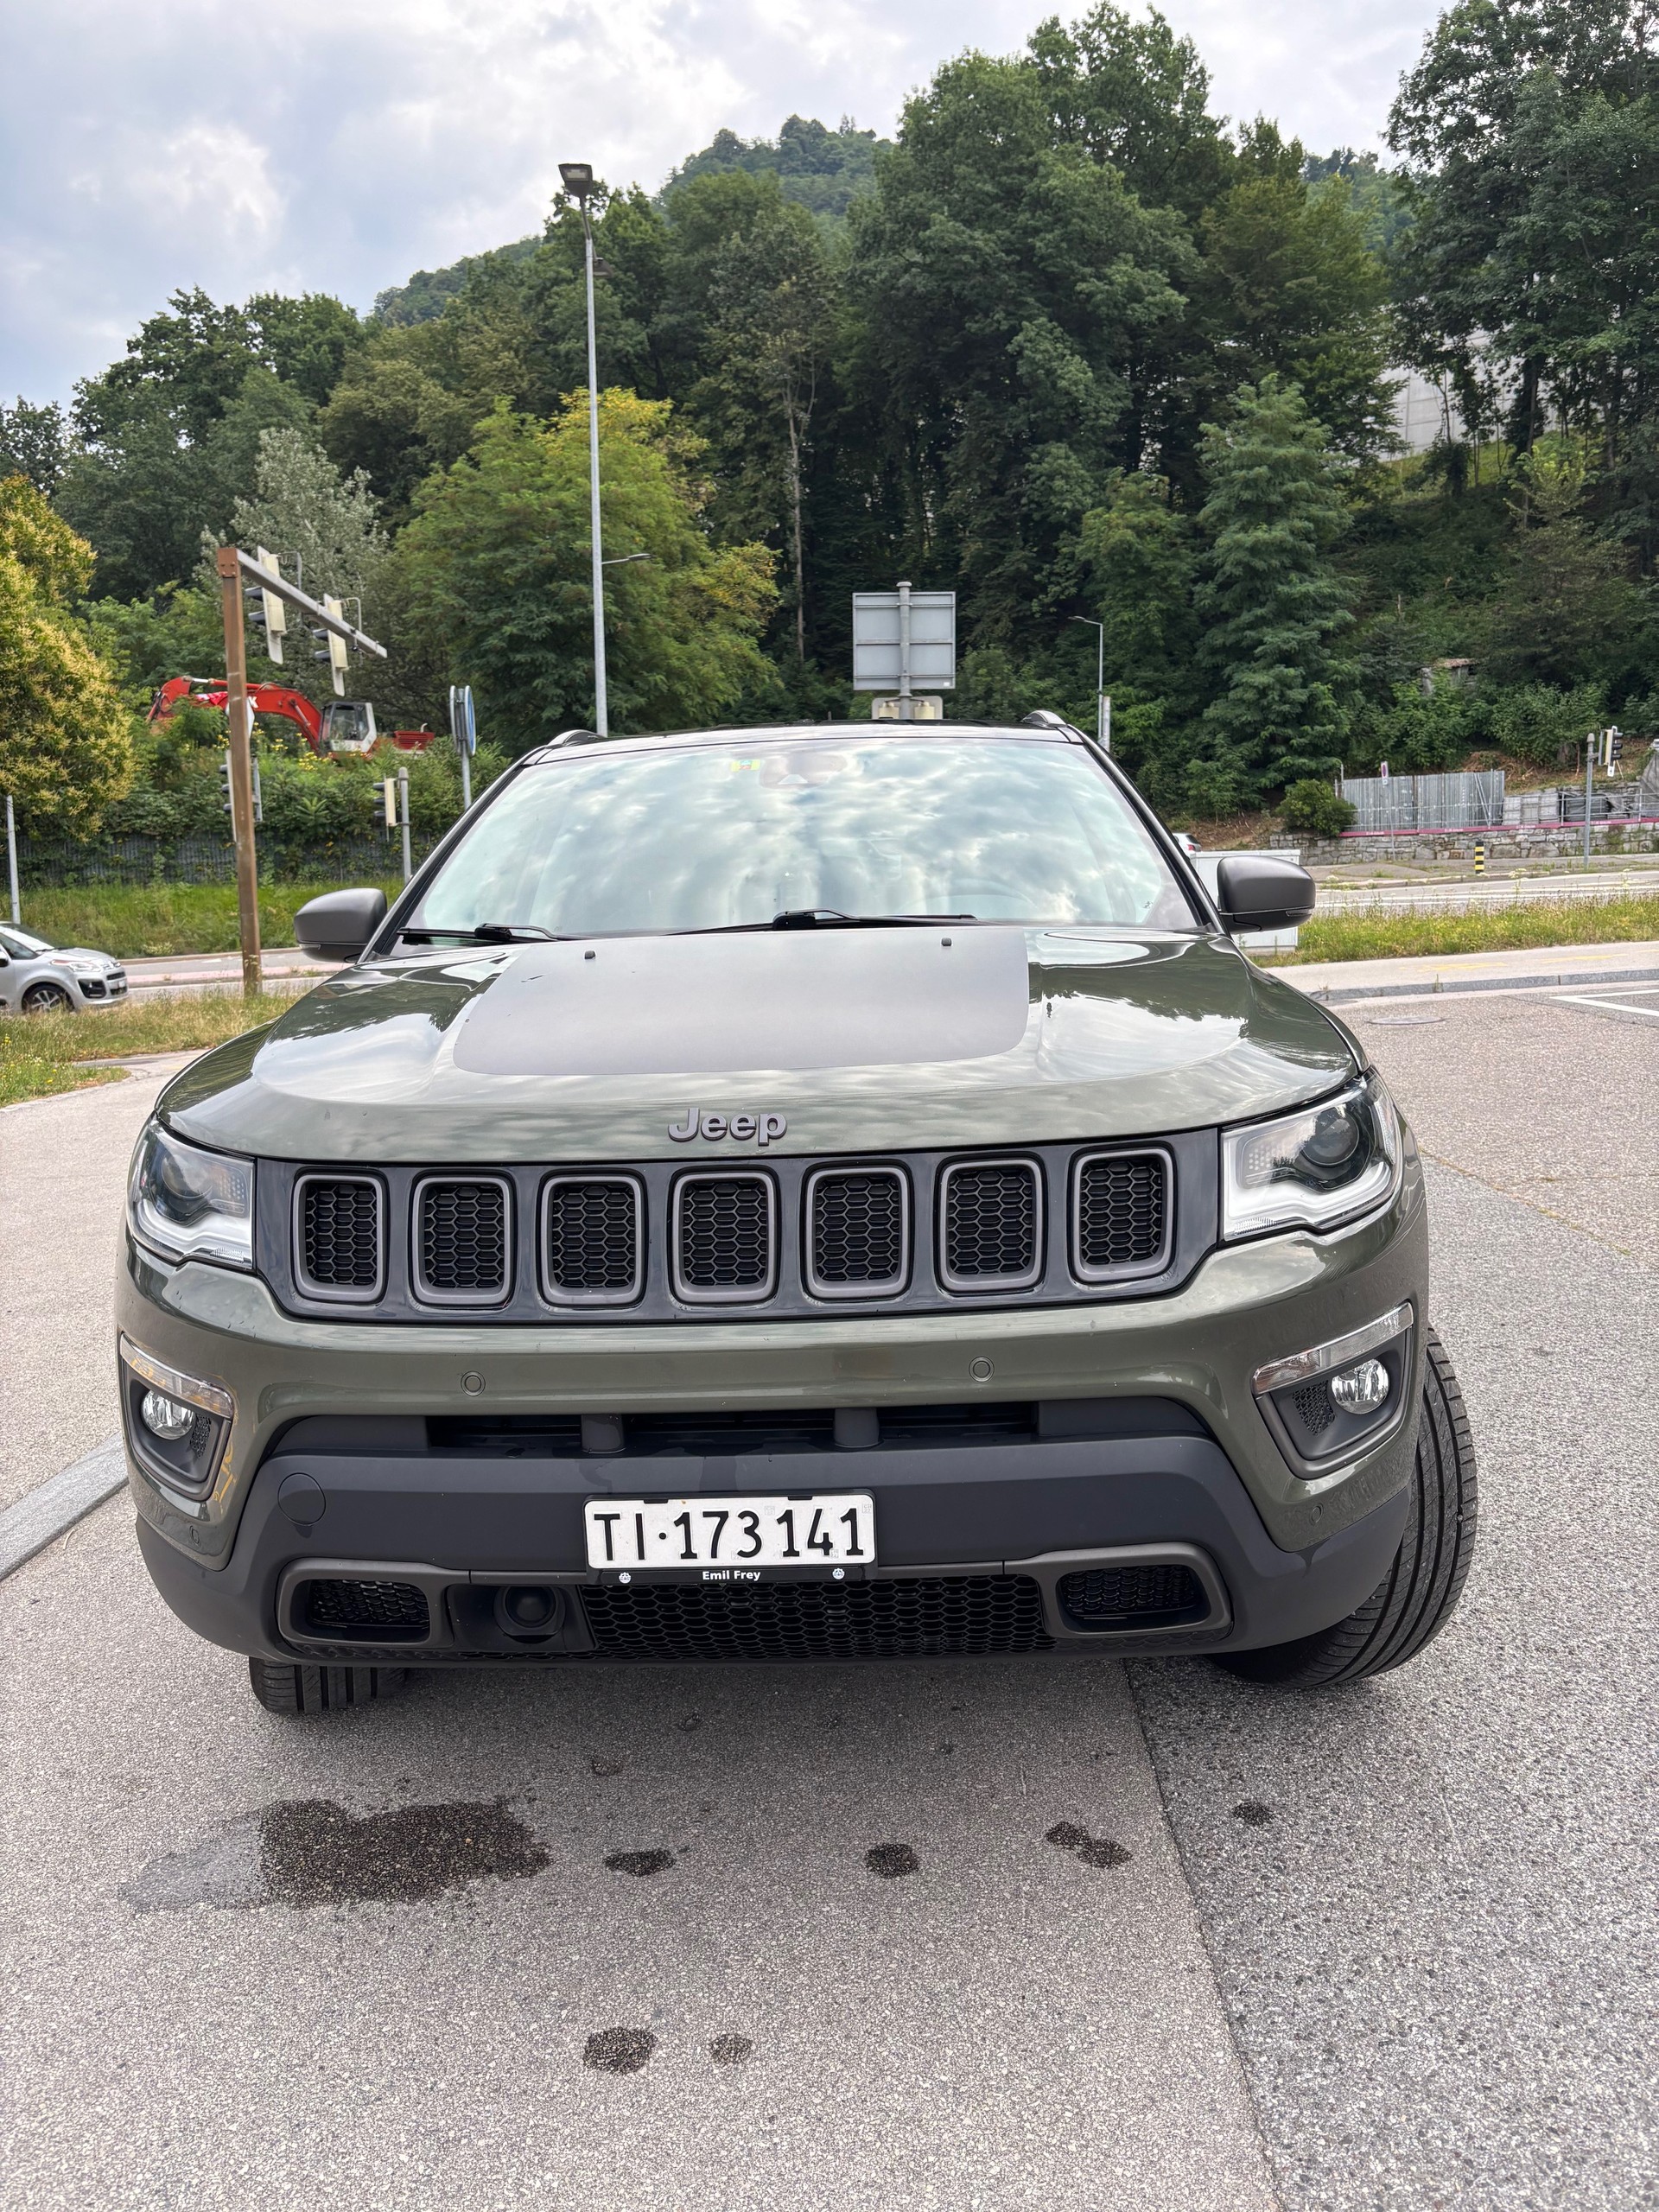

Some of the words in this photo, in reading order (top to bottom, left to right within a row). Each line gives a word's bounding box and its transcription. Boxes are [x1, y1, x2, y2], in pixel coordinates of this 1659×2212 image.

[668, 1108, 787, 1147] Jeep
[702, 1569, 731, 1581] Emil
[734, 1569, 762, 1582] Frey
